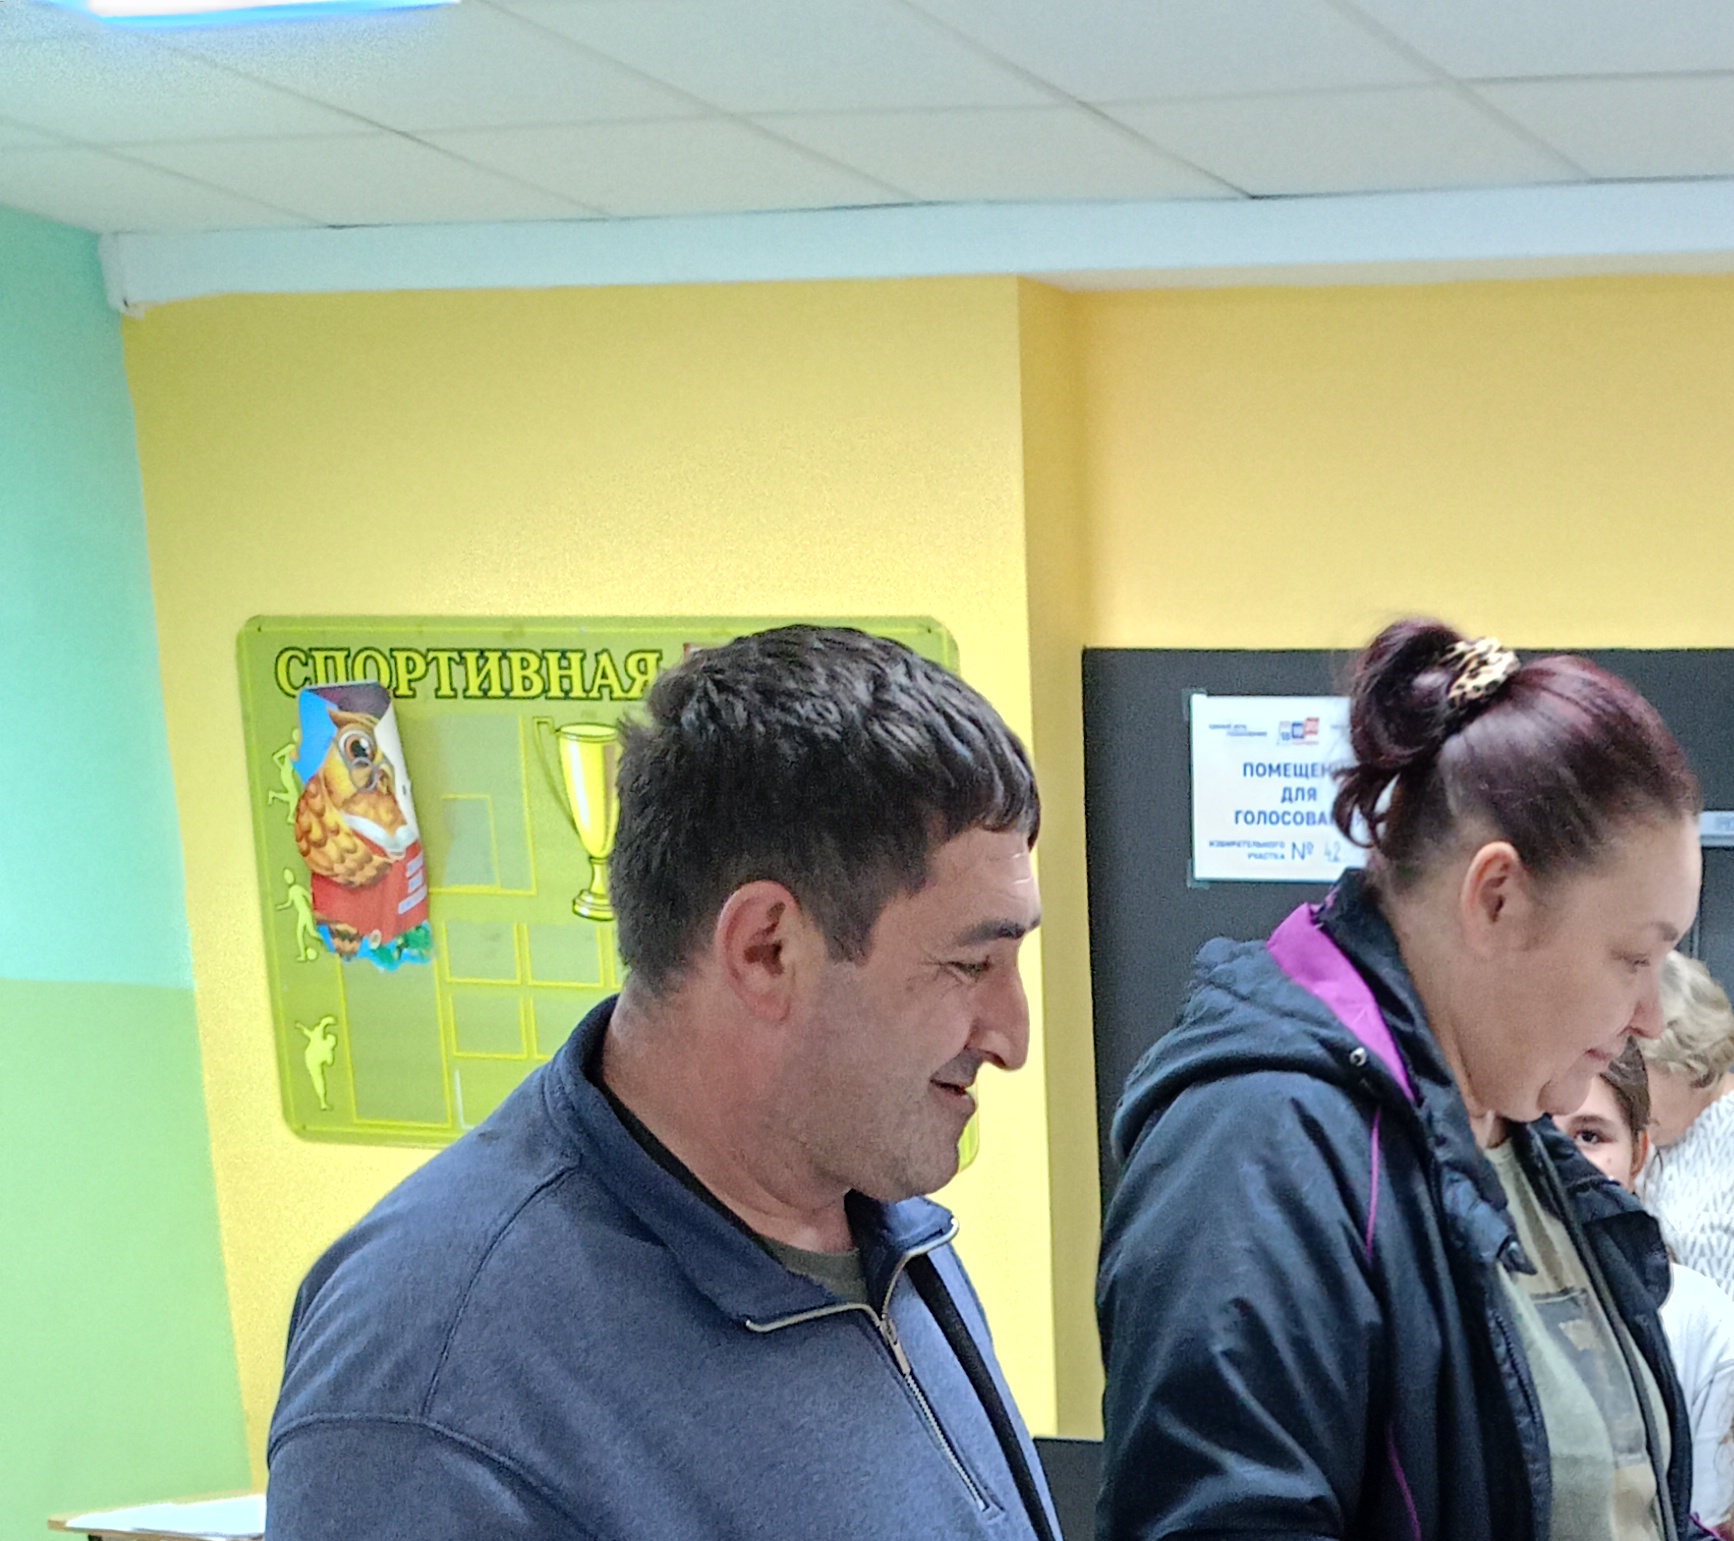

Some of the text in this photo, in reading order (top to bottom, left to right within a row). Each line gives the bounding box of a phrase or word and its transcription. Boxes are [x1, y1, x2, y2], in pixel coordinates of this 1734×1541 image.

[274, 647, 662, 700] СПОРТИВНАЯ
[1243, 761, 1336, 780] ПОМЕЩЕН
[1280, 786, 1318, 804] ДЛЯ
[1234, 810, 1334, 827] ГОЛОСОВА
